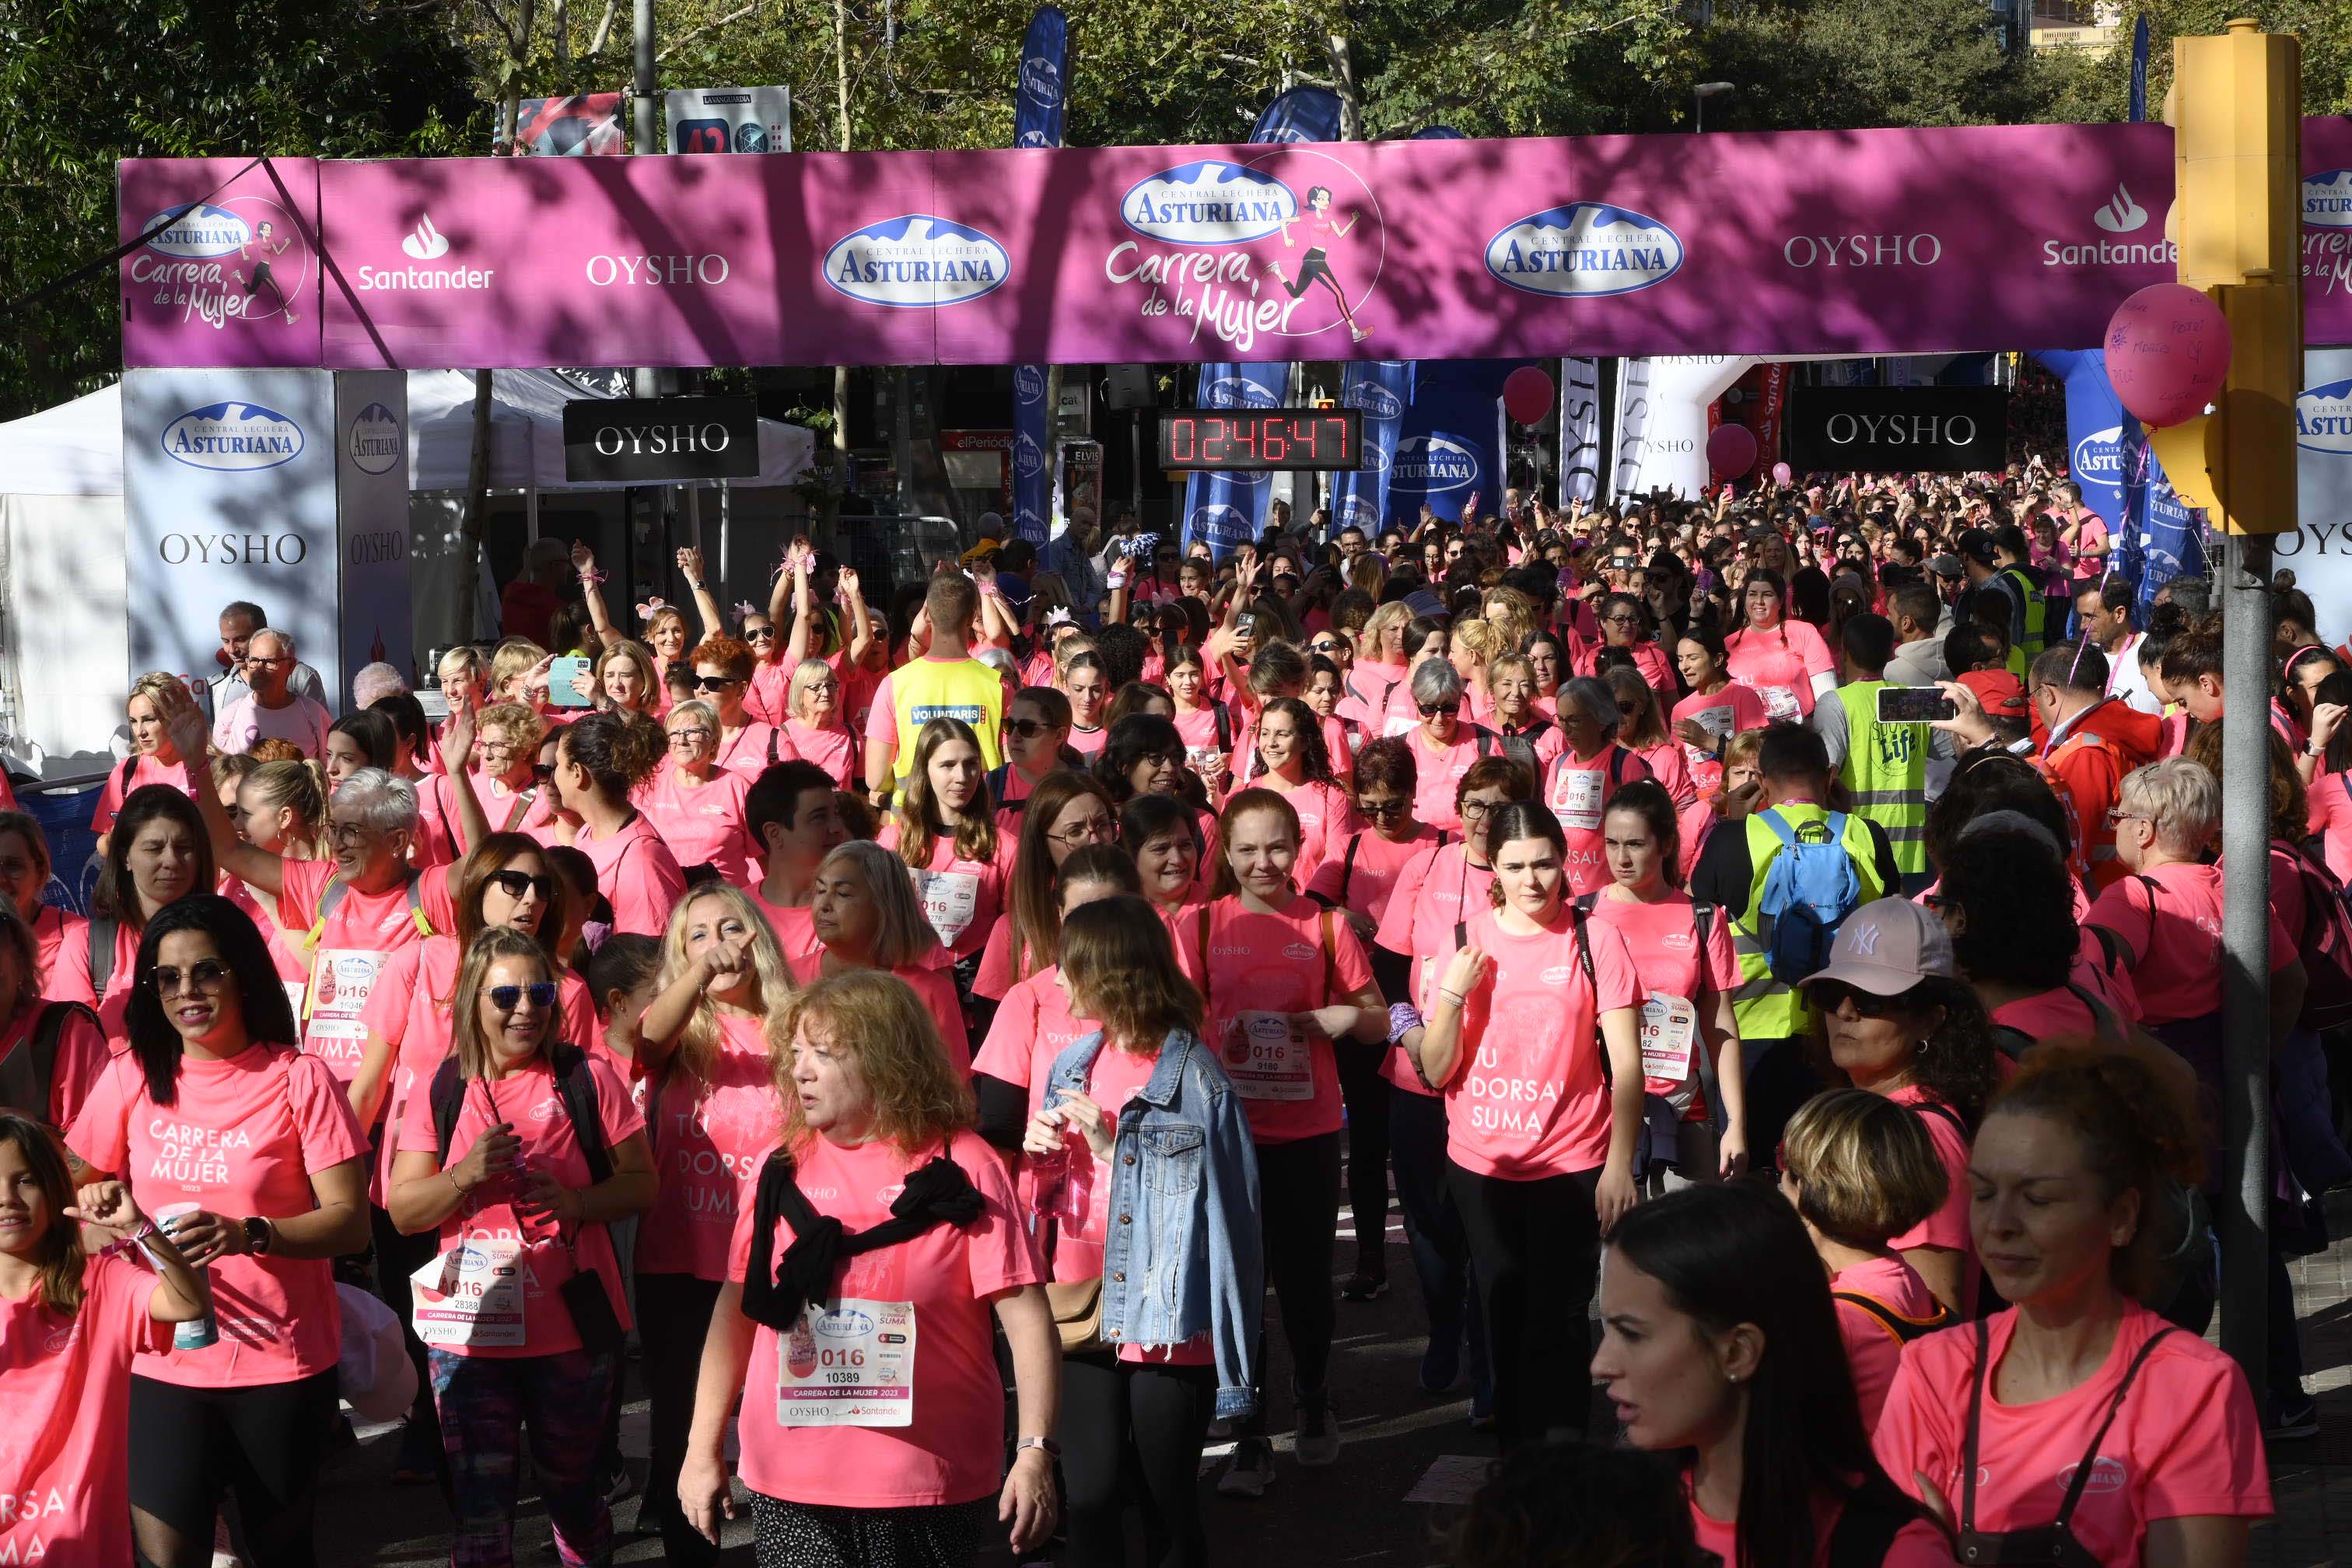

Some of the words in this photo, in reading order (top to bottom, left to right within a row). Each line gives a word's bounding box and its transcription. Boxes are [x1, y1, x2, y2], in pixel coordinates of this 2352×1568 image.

[1161, 190, 1216, 199] CENTRAL
[1223, 187, 1278, 198] LECHERA
[1133, 193, 1283, 225] ASTURIANA
[2302, 198, 2352, 213] STUR
[1531, 234, 1593, 246] CENTRAL
[1598, 233, 1661, 243] LECHERA
[2302, 233, 2352, 255] rre
[866, 247, 927, 256] CENTRAL
[931, 246, 989, 255] LECHERA
[1500, 237, 1668, 274] ASTURIANA
[1784, 233, 1942, 268] OYSHO
[2042, 239, 2179, 267] Santande
[131, 254, 222, 284] Carrera
[586, 254, 729, 286] OYSHO
[837, 249, 996, 283] ASTURIANA
[1105, 240, 1251, 284] Carrera
[2315, 254, 2330, 277] la
[359, 265, 494, 290] Santander
[153, 286, 170, 305] de
[173, 283, 187, 305] la
[184, 281, 257, 330] Mujer
[1141, 286, 1167, 317] de
[1174, 285, 1194, 317] la
[1189, 278, 1305, 352] Mujer
[595, 423, 730, 456] OYSHO
[1172, 418, 1348, 461] 02:46:47
[1826, 413, 1976, 446] OYSHO
[173, 427, 294, 454] ASTURIANA
[353, 430, 398, 457] ASTURIANA
[1645, 439, 1693, 454] YSHO
[1075, 450, 1099, 462] ELVIS
[159, 533, 307, 565] OYSHO
[352, 530, 403, 565] OYSHO
[912, 709, 978, 720] VOLUNTARIS
[1880, 729, 1916, 764] Life
[1569, 792, 1586, 801] 016
[922, 900, 947, 912] 016
[1213, 945, 1251, 957] OYSHO
[338, 985, 368, 998] 016
[1641, 1024, 1660, 1037] 16
[1253, 1045, 1285, 1059] 016
[1642, 1039, 1652, 1048] 82
[1257, 1062, 1278, 1071] 9180
[1651, 1062, 1681, 1072] Santander
[675, 1113, 710, 1139] TU
[1471, 1105, 1543, 1133] SUMA
[149, 1119, 250, 1148] CARRERA
[160, 1142, 193, 1162] DE
[198, 1148, 225, 1163] LA
[149, 1158, 229, 1184] MUJER
[677, 1150, 754, 1181] DORS
[180, 1184, 201, 1192] 2023
[450, 1280, 483, 1297] 016
[427, 1311, 457, 1320] CARRERA
[454, 1300, 478, 1311] 28388
[424, 1326, 457, 1336] OYSHO
[880, 1317, 906, 1325] SUMA
[821, 1348, 865, 1367] 016
[825, 1372, 860, 1384] 10389
[793, 1389, 828, 1398] CARRERA
[789, 1406, 830, 1417] OYSHO
[861, 1406, 901, 1416] Santander
